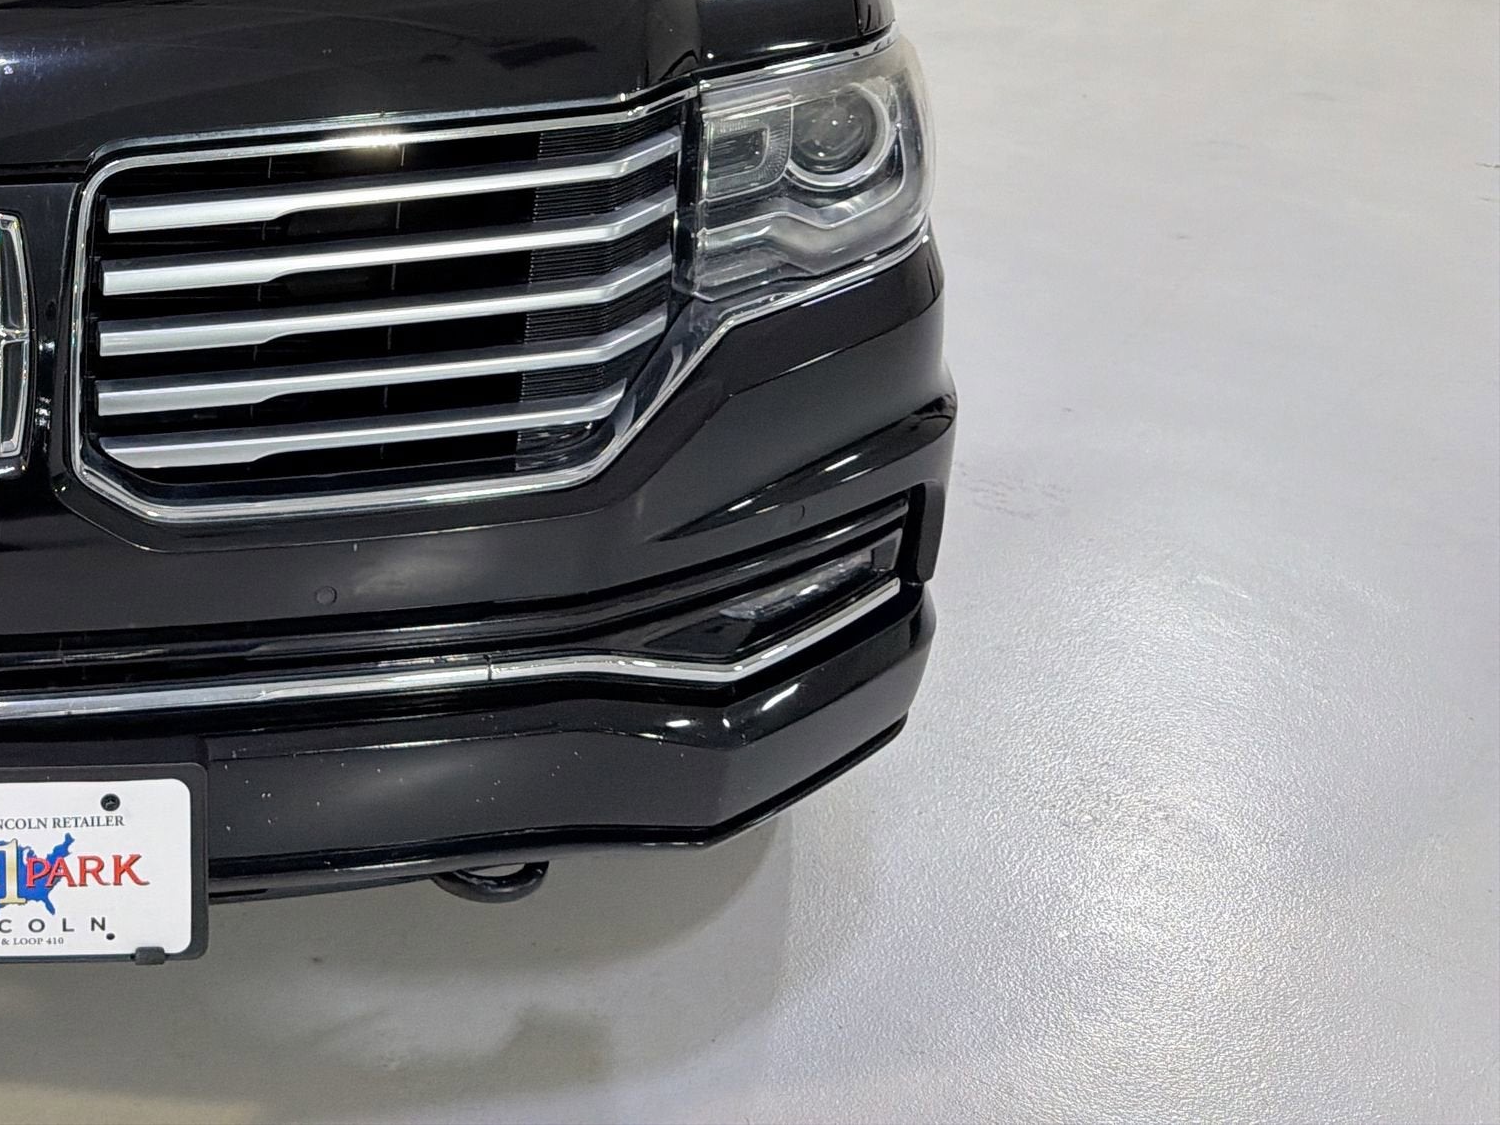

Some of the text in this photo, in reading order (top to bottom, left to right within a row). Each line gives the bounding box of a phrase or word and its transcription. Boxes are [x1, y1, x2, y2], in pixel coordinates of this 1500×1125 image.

[52, 815, 125, 829] RETAILER
[25, 854, 150, 889] PARK
[1, 937, 10, 946] &
[13, 936, 44, 946] LOOP
[45, 936, 64, 946] 410
